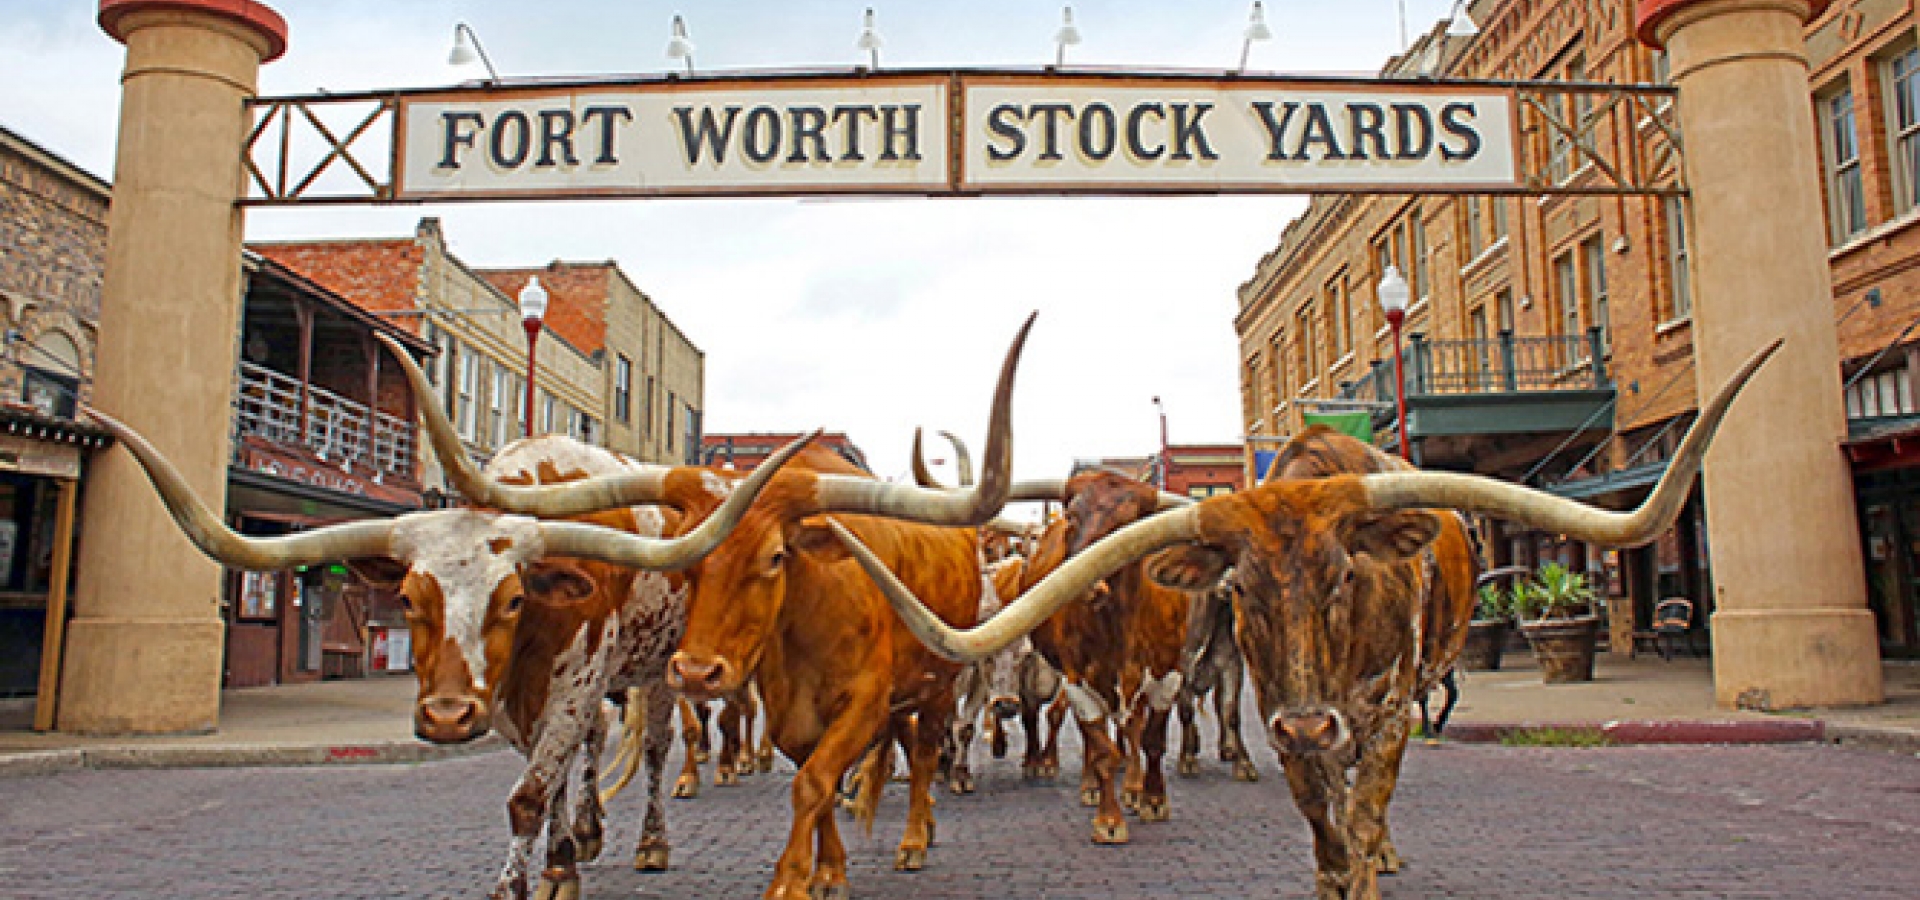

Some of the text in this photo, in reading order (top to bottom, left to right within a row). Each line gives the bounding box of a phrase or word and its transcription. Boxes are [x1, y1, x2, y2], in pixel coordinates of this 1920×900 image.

[437, 102, 1482, 169] FORT WORTH STOCK YARDS
